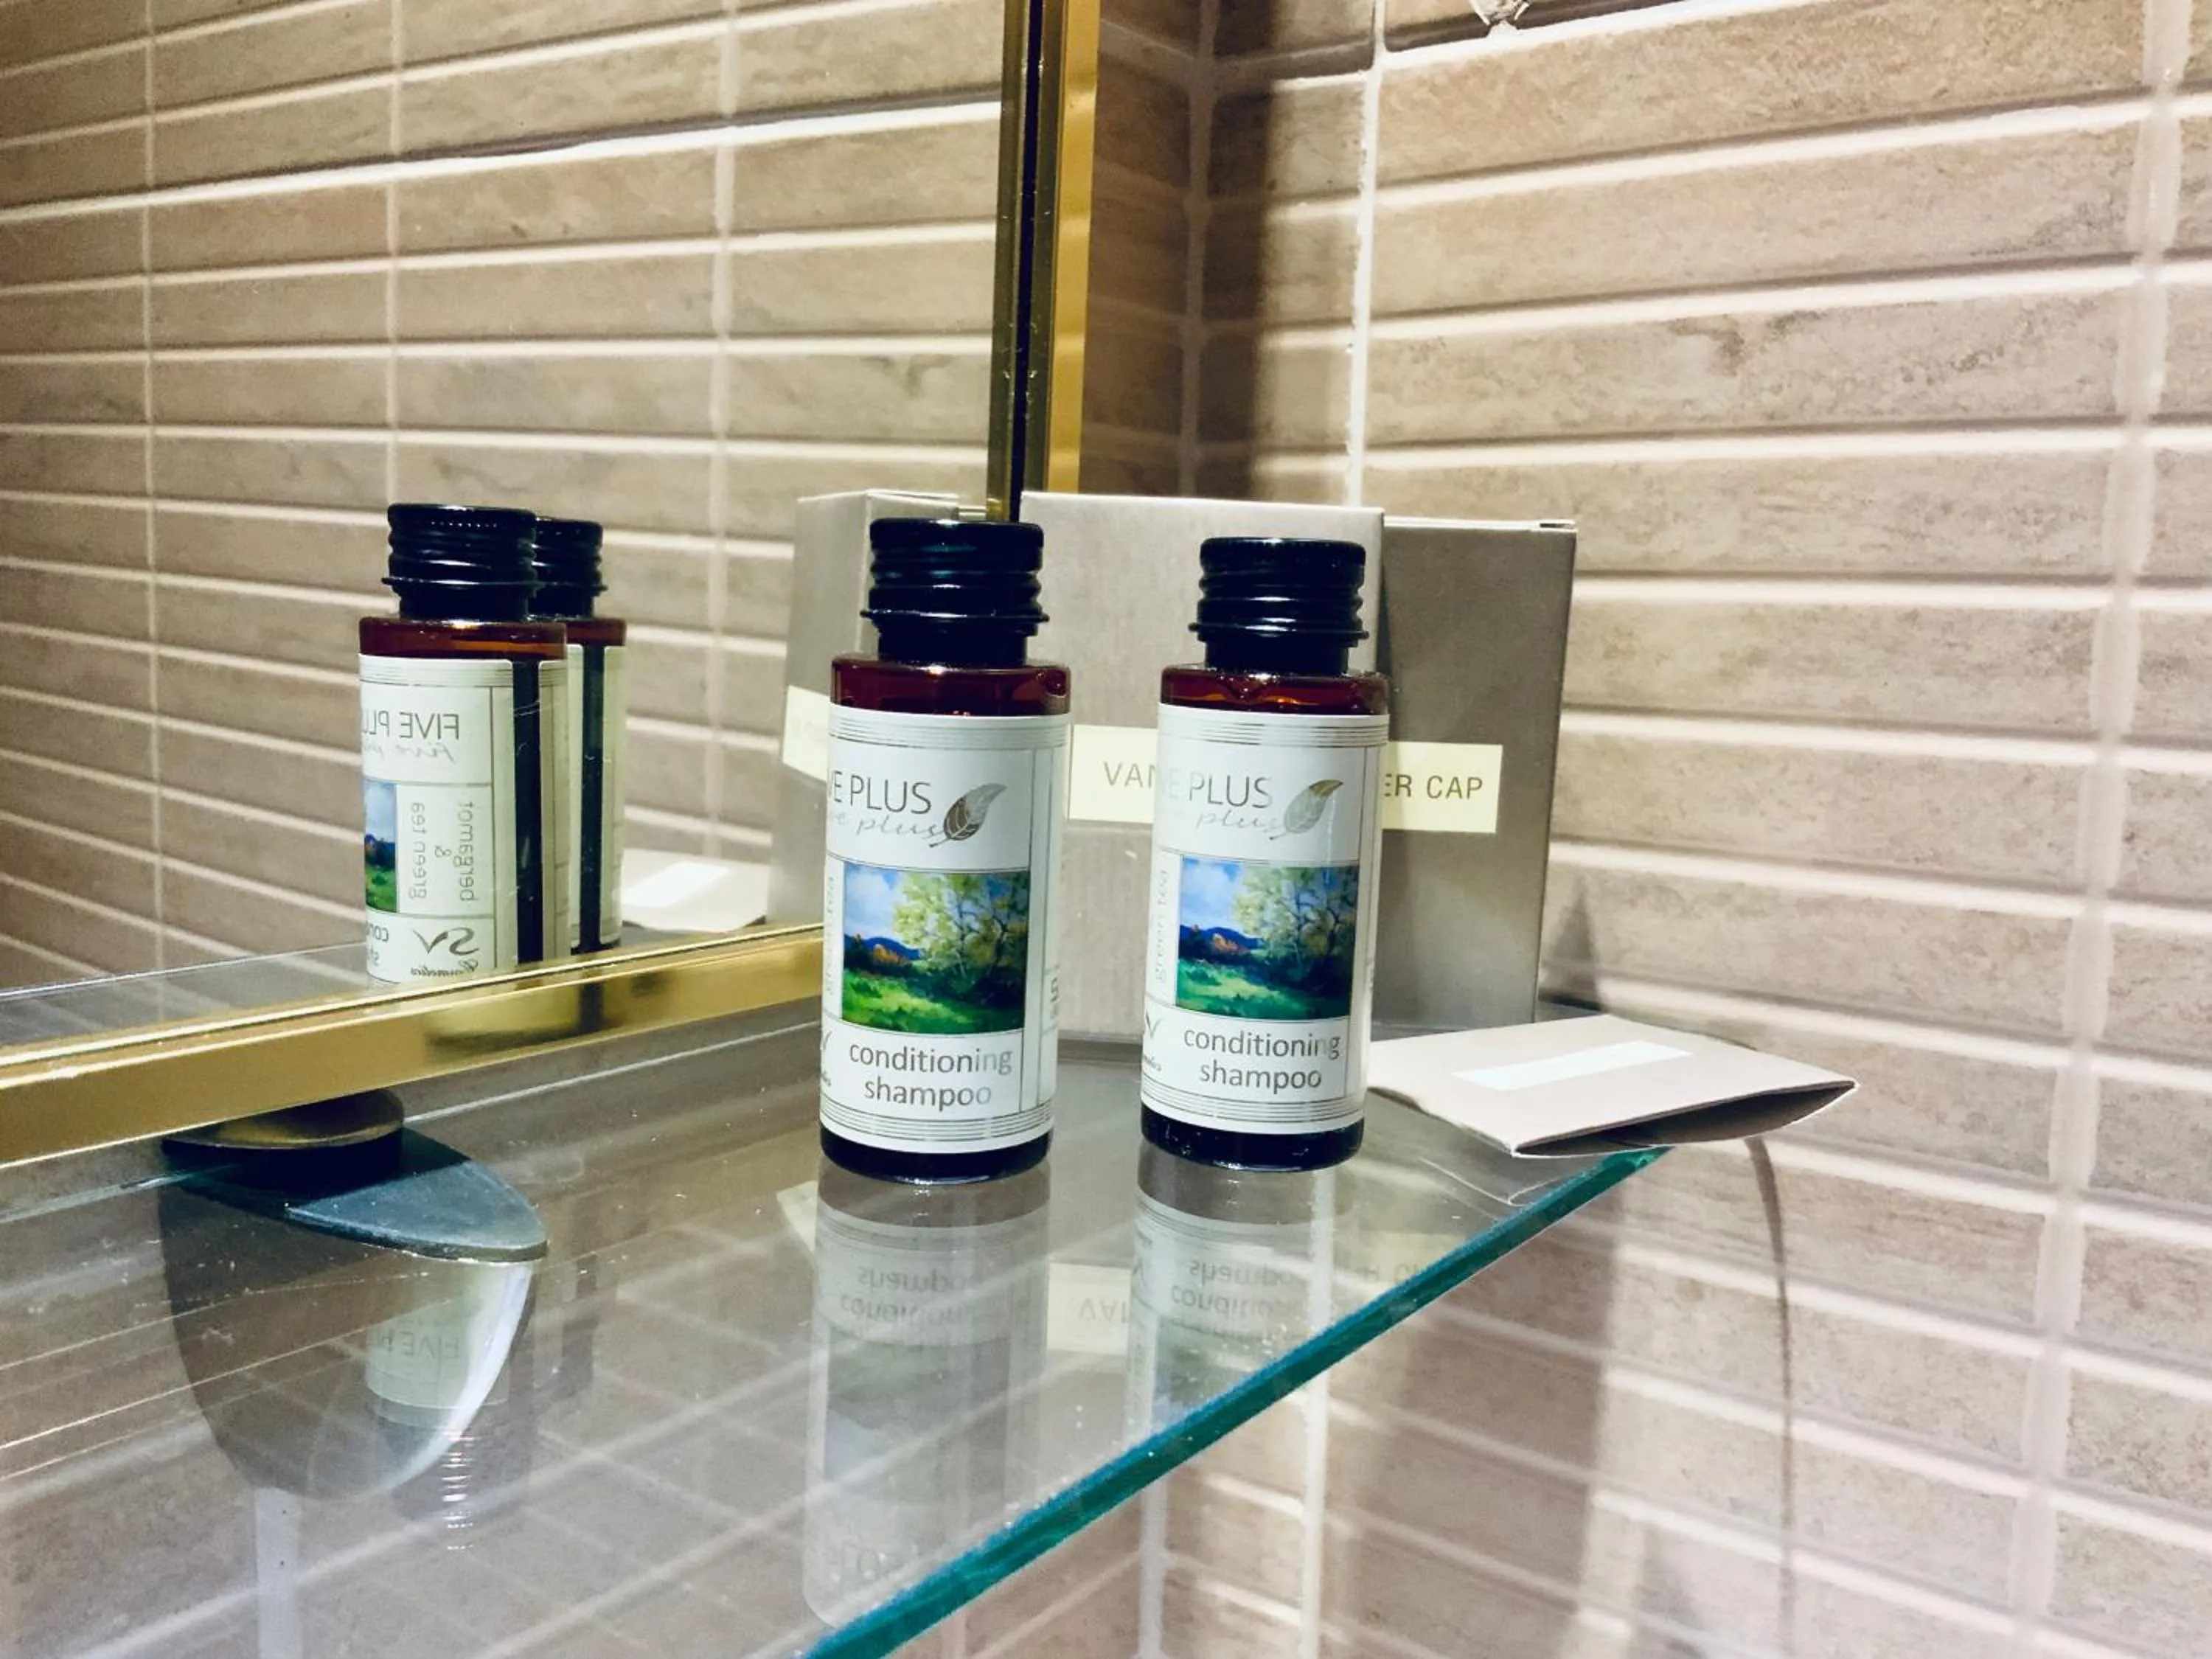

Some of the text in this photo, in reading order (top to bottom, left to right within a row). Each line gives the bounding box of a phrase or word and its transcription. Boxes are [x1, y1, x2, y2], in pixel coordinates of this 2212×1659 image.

[850, 774, 931, 815] PLUS
[1188, 771, 1273, 810] PLUS
[1426, 775, 1484, 800] CAP
[849, 1044, 1013, 1076] conditioning
[1183, 1028, 1342, 1060] conditioning
[864, 1076, 992, 1112] shampoo
[1200, 1060, 1323, 1095] shampoo
